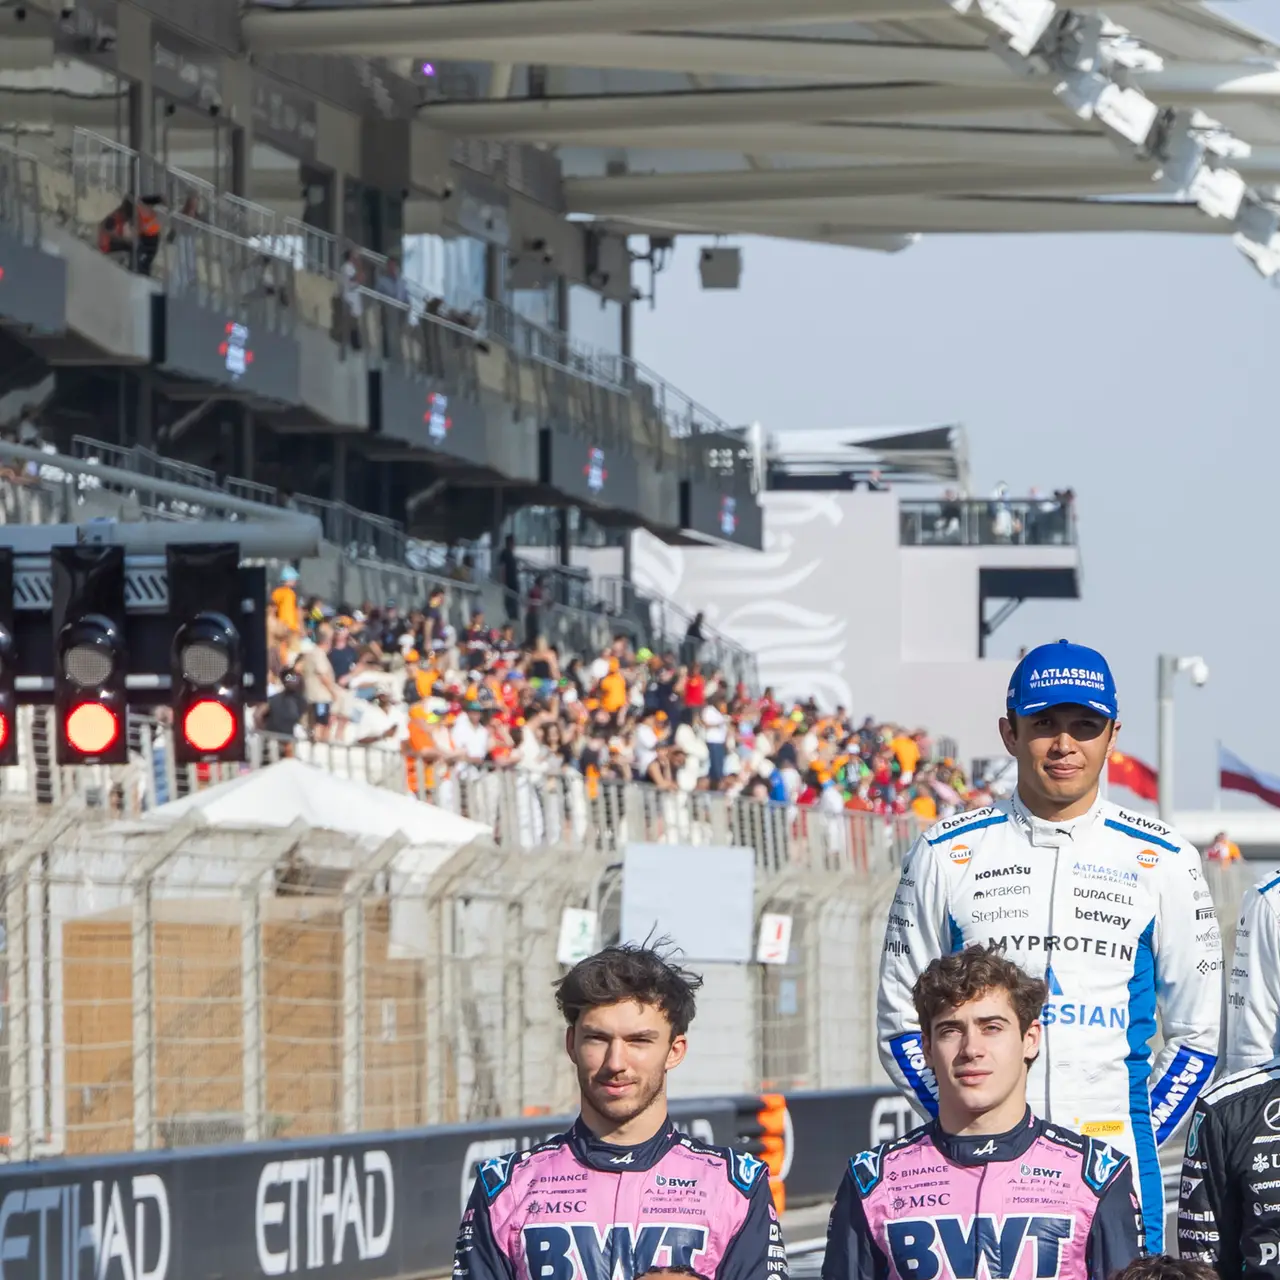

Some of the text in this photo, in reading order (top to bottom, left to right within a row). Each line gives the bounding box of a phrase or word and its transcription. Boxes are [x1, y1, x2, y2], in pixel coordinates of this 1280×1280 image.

[1030, 669, 1105, 691] ATLASSIAN WILLIAMS RACING
[1119, 810, 1171, 836] betway
[950, 850, 972, 859] Gulf
[1137, 854, 1159, 863] Gulf
[975, 865, 1031, 880] KOMATSU
[985, 884, 1030, 899] kraken
[1074, 888, 1134, 906] DURACELL
[971, 907, 1029, 923] Stephens
[1075, 907, 1131, 930] betway
[988, 936, 1133, 961] MYPROTEIN
[1039, 1004, 1126, 1029] SSIAN
[540, 1174, 588, 1183] BINANCE
[901, 1166, 948, 1177] BINANCE
[1033, 1169, 1062, 1178] BWT
[669, 1179, 698, 1187] BWT
[1008, 1179, 1071, 1188] ALPINE
[645, 1189, 707, 1197] ALPINE
[545, 1201, 587, 1213] MSC
[910, 1194, 951, 1208] MSC
[255, 1150, 394, 1277] ETIHAD
